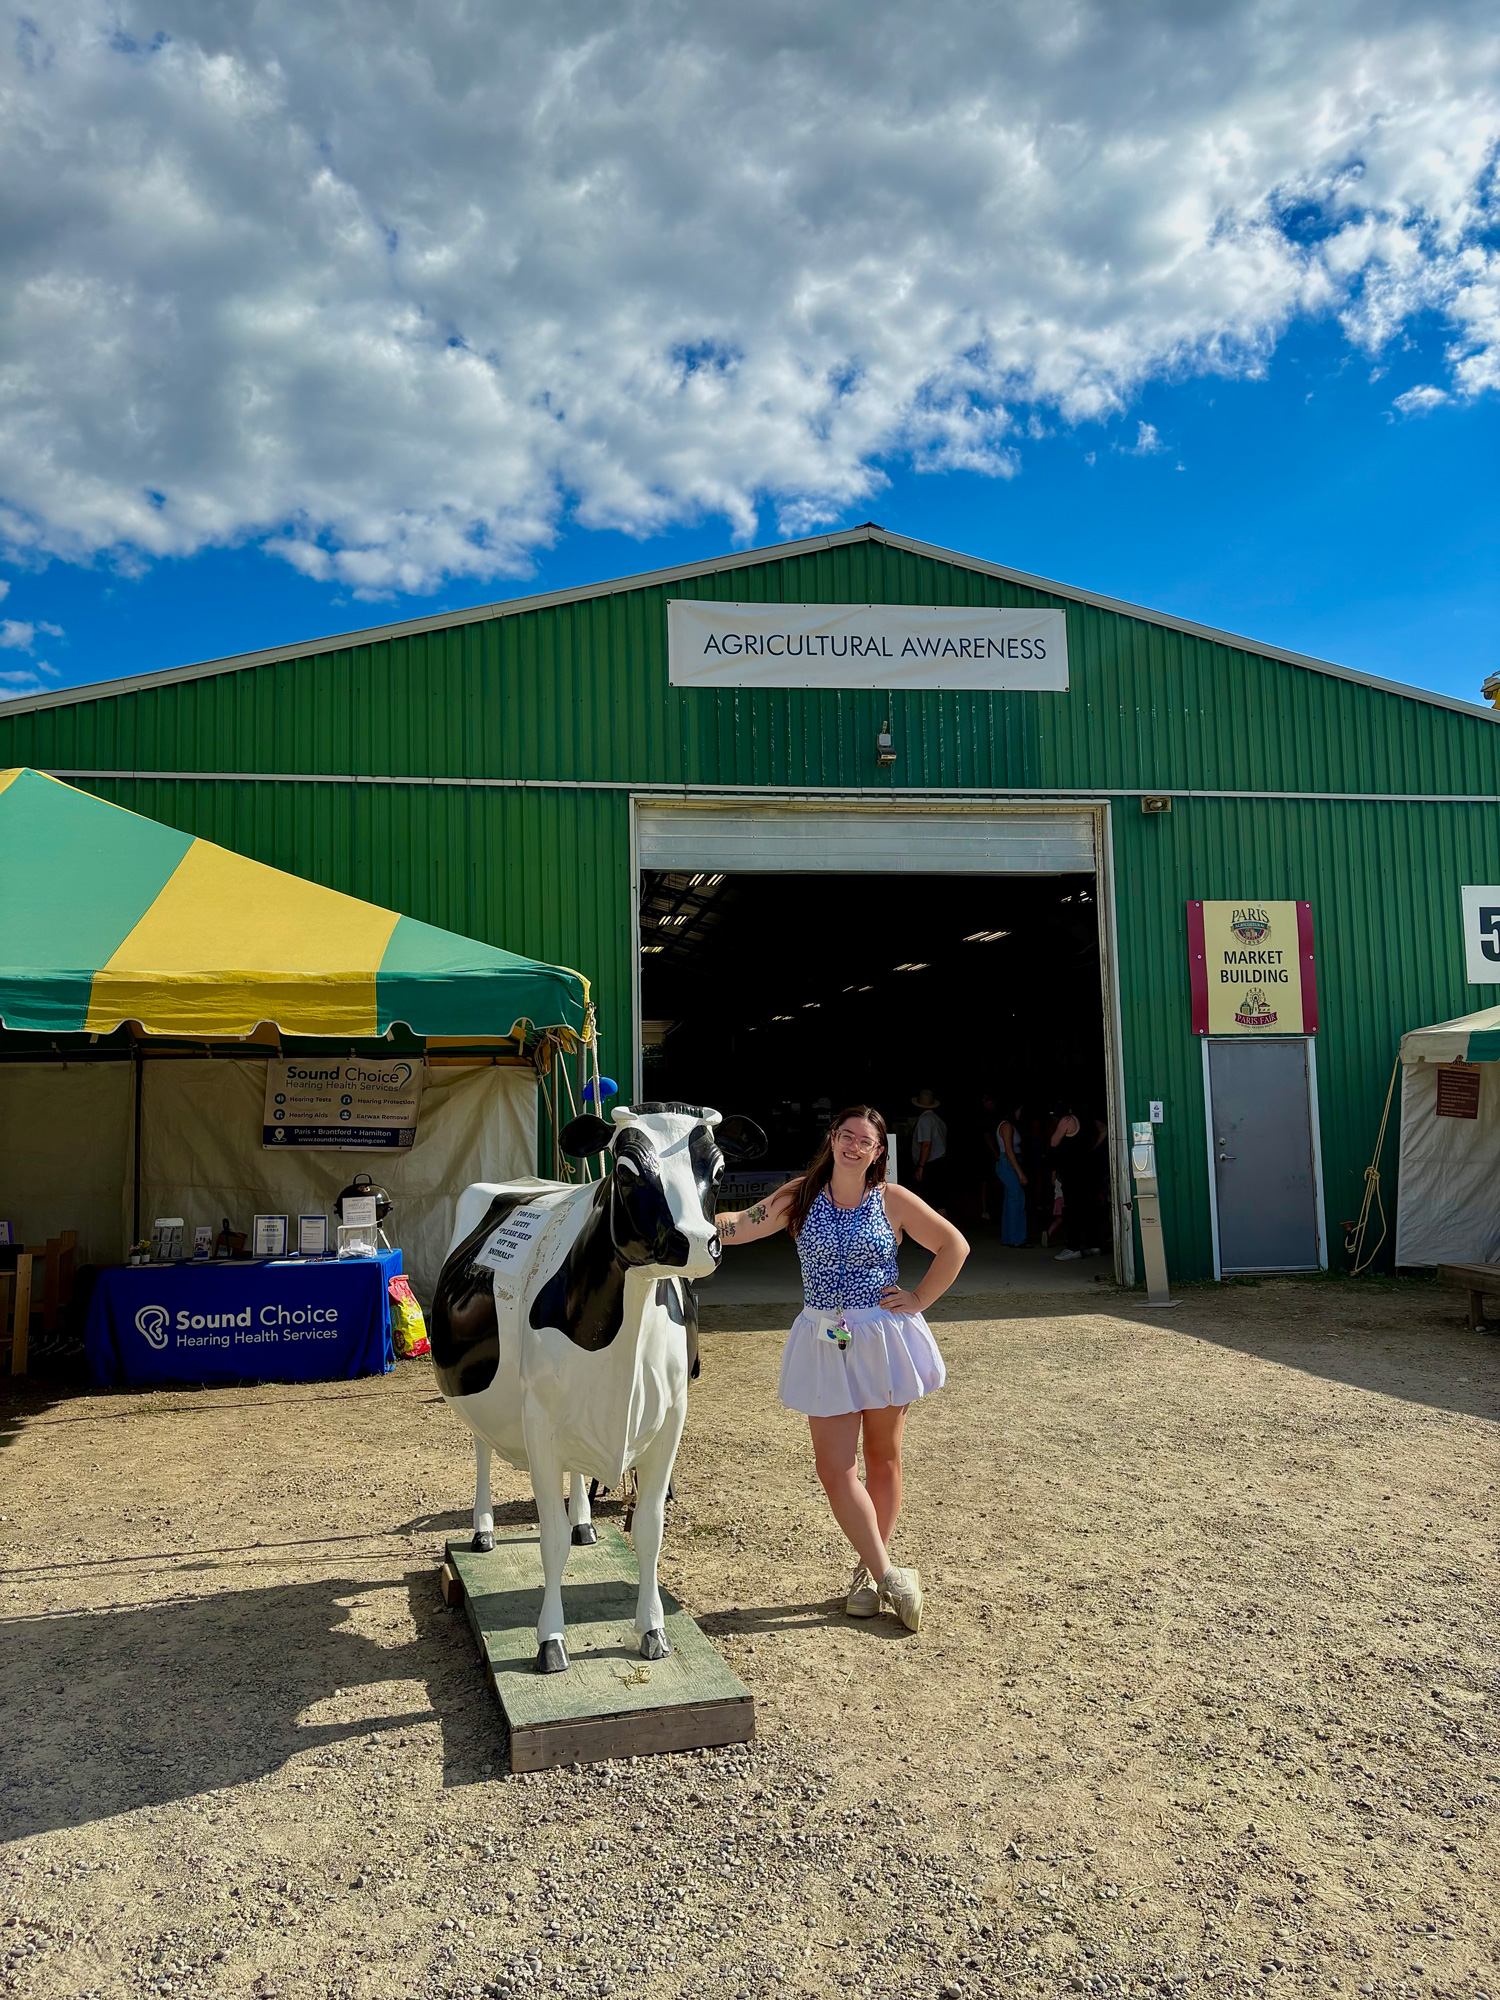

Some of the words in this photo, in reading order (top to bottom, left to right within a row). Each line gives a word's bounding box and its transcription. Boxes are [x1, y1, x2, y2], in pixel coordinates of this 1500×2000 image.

[703, 634, 893, 657] AGRICULTURAL
[900, 637, 1046, 660] AWARENESS
[1231, 908, 1270, 923] PARIS
[1479, 907, 1500, 962] 5
[1223, 951, 1283, 965] MARKET
[1220, 970, 1289, 983] BUILDING
[1237, 1014, 1258, 1024] PARIS
[1260, 1013, 1277, 1024] FAIR
[286, 1066, 340, 1080] Sound
[345, 1067, 399, 1083] Choice
[286, 1080, 323, 1091] Hearing
[326, 1080, 357, 1090] Health
[360, 1082, 399, 1092] Services
[318, 1128, 352, 1136] Brantford
[359, 1129, 391, 1137] Hamilton
[298, 1136, 386, 1144] www.soundchoicehearing.com
[517, 1231, 532, 1240] KEEP
[506, 1241, 518, 1250] THE
[176, 1307, 251, 1330] Sound
[260, 1304, 338, 1326] Choice
[176, 1333, 230, 1348] Hearing
[234, 1330, 279, 1344] Health
[283, 1328, 338, 1341] Services
